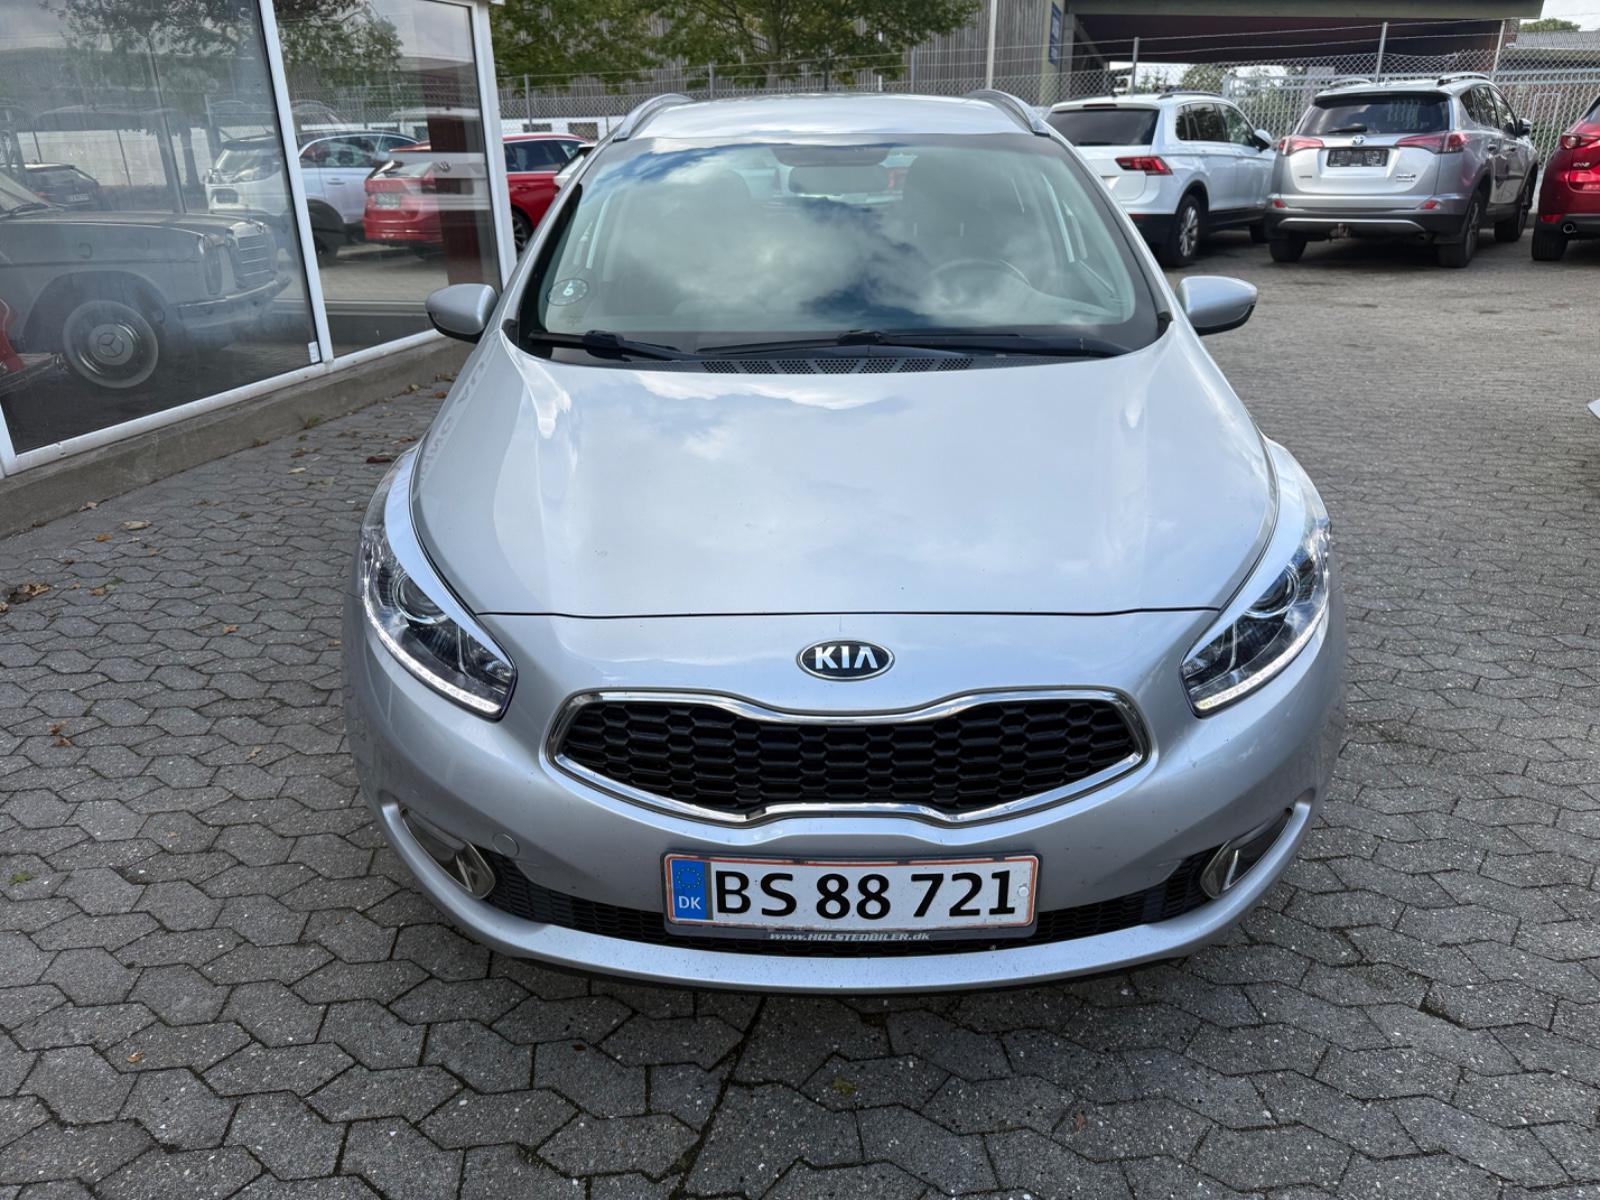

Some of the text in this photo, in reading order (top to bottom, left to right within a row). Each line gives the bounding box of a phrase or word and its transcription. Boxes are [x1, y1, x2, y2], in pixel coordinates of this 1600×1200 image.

[814, 645, 879, 669] KIA
[678, 896, 702, 910] DK
[715, 869, 1016, 920] BS 88 721
